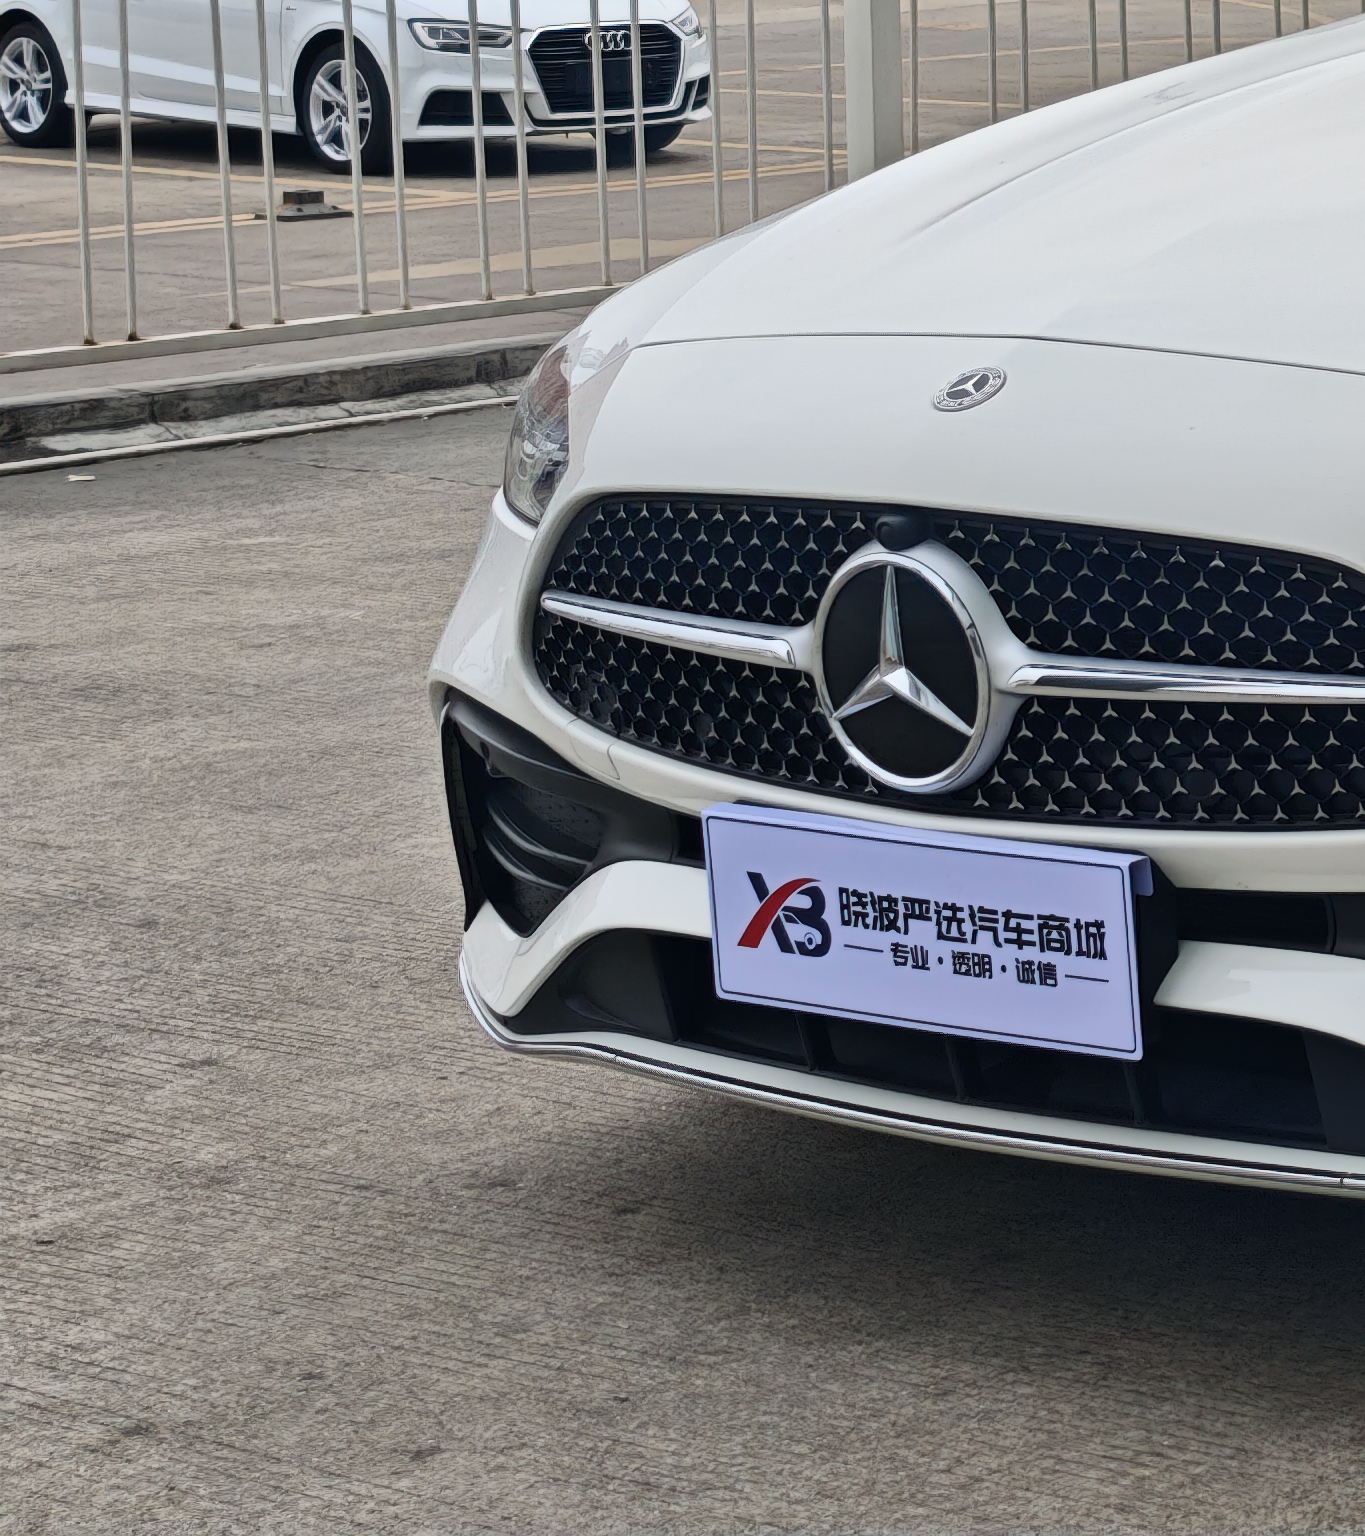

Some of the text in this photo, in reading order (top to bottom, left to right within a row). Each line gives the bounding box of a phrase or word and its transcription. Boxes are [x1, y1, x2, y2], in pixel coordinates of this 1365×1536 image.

[838, 886, 1108, 961] 晓波严选汽车商城
